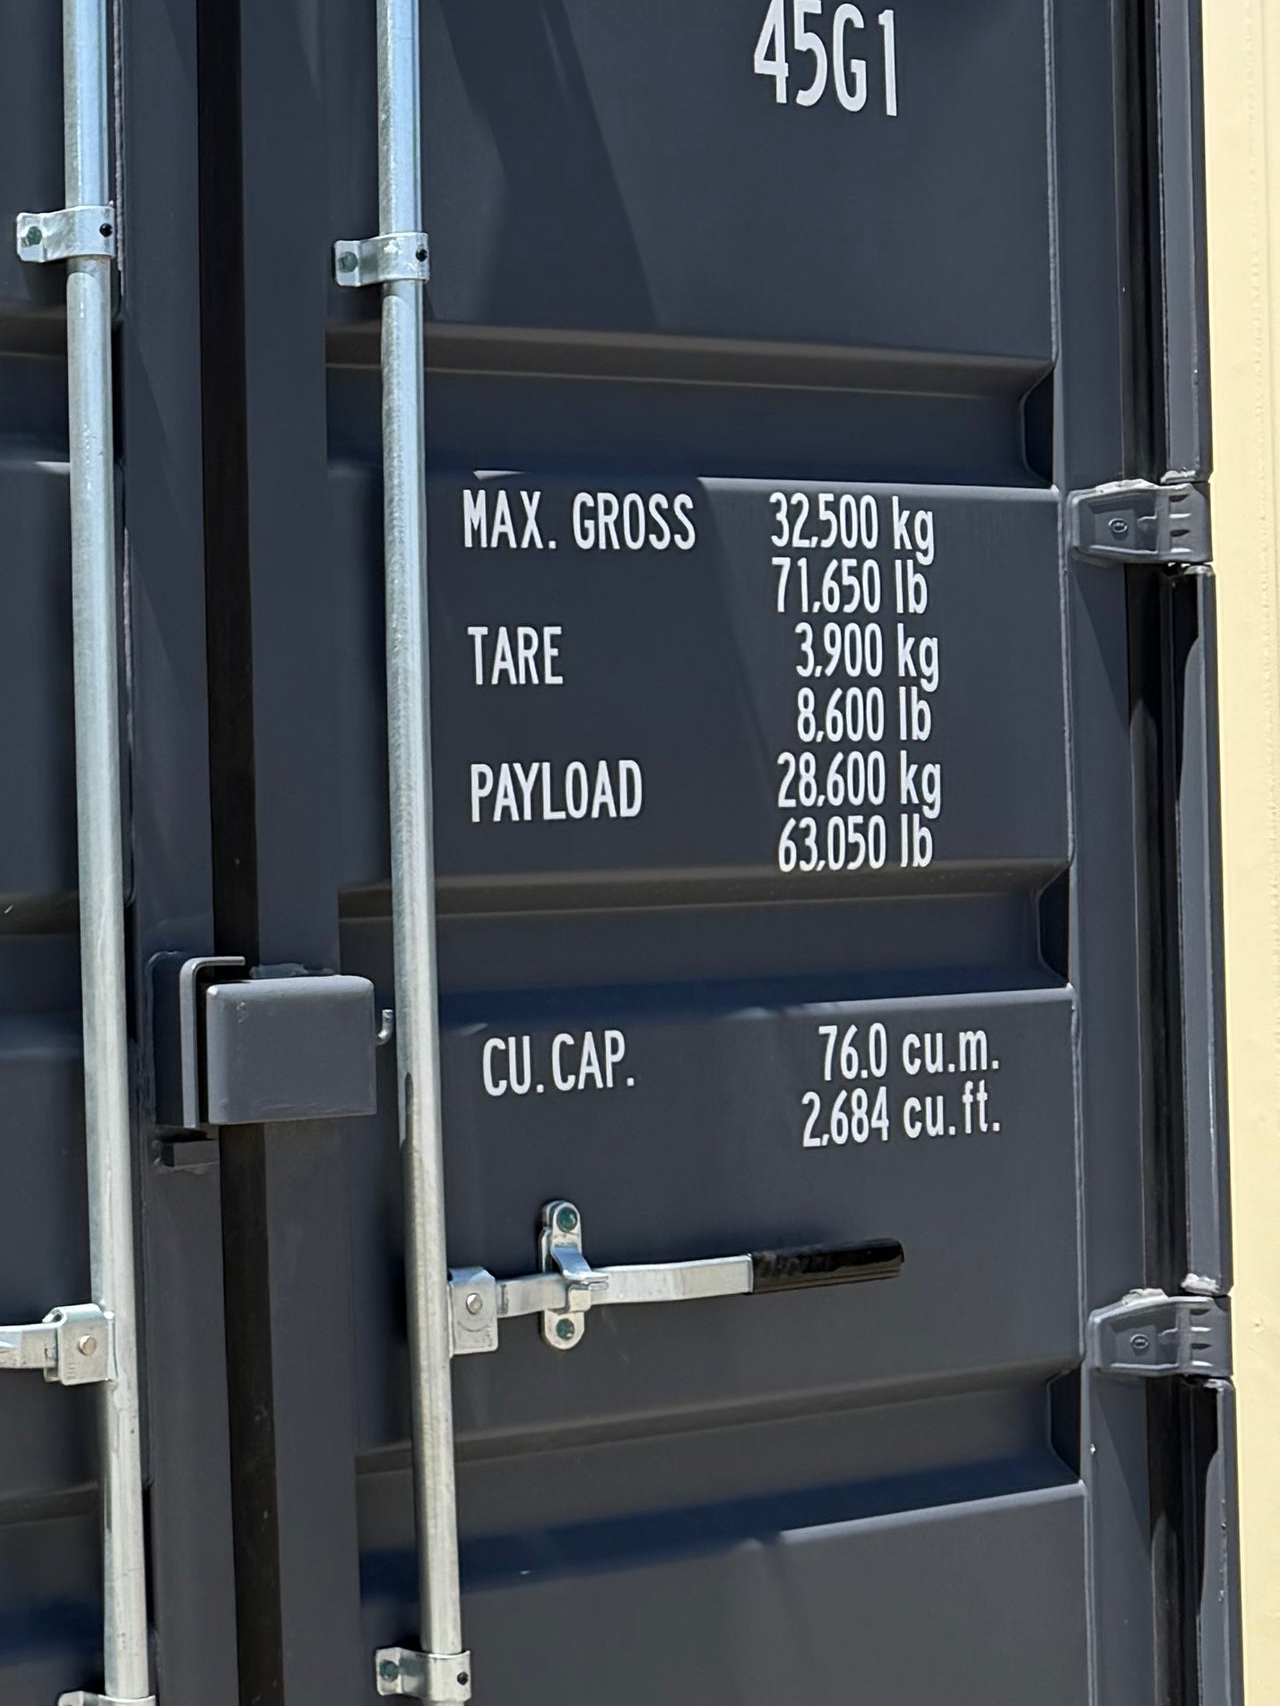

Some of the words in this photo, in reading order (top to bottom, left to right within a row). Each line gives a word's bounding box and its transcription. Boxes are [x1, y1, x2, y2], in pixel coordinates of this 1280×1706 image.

[463, 490, 556, 550] MAX.
[573, 493, 696, 550] GROSS
[770, 493, 879, 550] 32,500
[893, 496, 936, 566] kg
[772, 557, 881, 614] 71,650
[895, 555, 928, 614] lb
[468, 627, 564, 686] TARE
[795, 622, 883, 678] 3,900
[898, 623, 939, 694] kg
[798, 687, 885, 743] 8,600
[899, 684, 931, 742] lb
[471, 760, 643, 823] PAYLOAD
[777, 751, 886, 808] 28,600
[901, 754, 942, 820] kg
[779, 815, 886, 873] 63,050
[901, 815, 933, 868] lb
[483, 1030, 635, 1097] CU.CAP.
[819, 1023, 888, 1081] 76.0
[903, 1030, 999, 1076] cu.m.
[802, 1090, 890, 1148] 2,684
[904, 1080, 1000, 1139] cu.ft.
